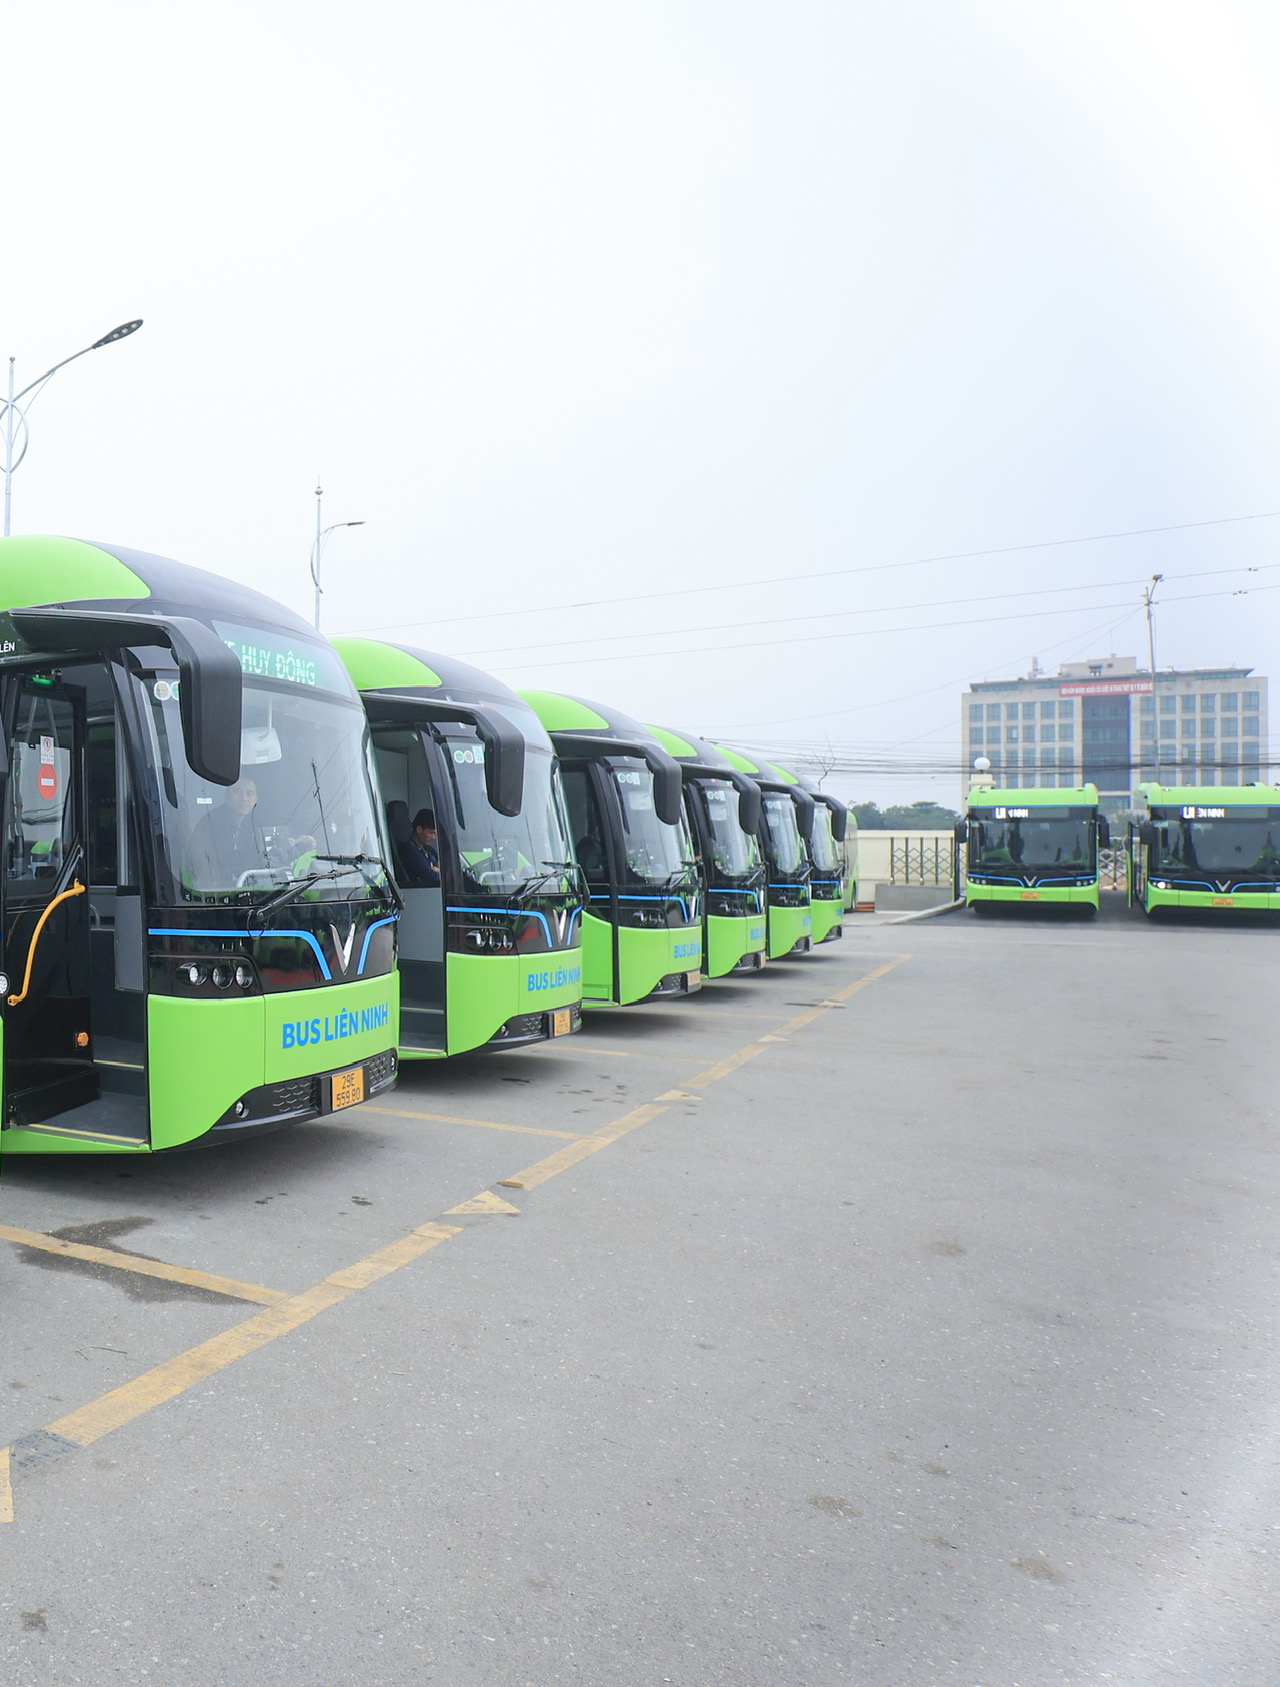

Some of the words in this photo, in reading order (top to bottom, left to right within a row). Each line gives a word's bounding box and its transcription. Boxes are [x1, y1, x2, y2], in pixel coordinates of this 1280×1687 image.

[242, 644, 271, 676] HUY
[527, 972, 549, 991] BUS
[550, 965, 567, 988] LIÊN
[282, 1018, 321, 1049] BUS
[324, 1007, 359, 1042] LIÊN
[361, 1002, 389, 1033] NINH
[342, 1072, 355, 1090] 29E
